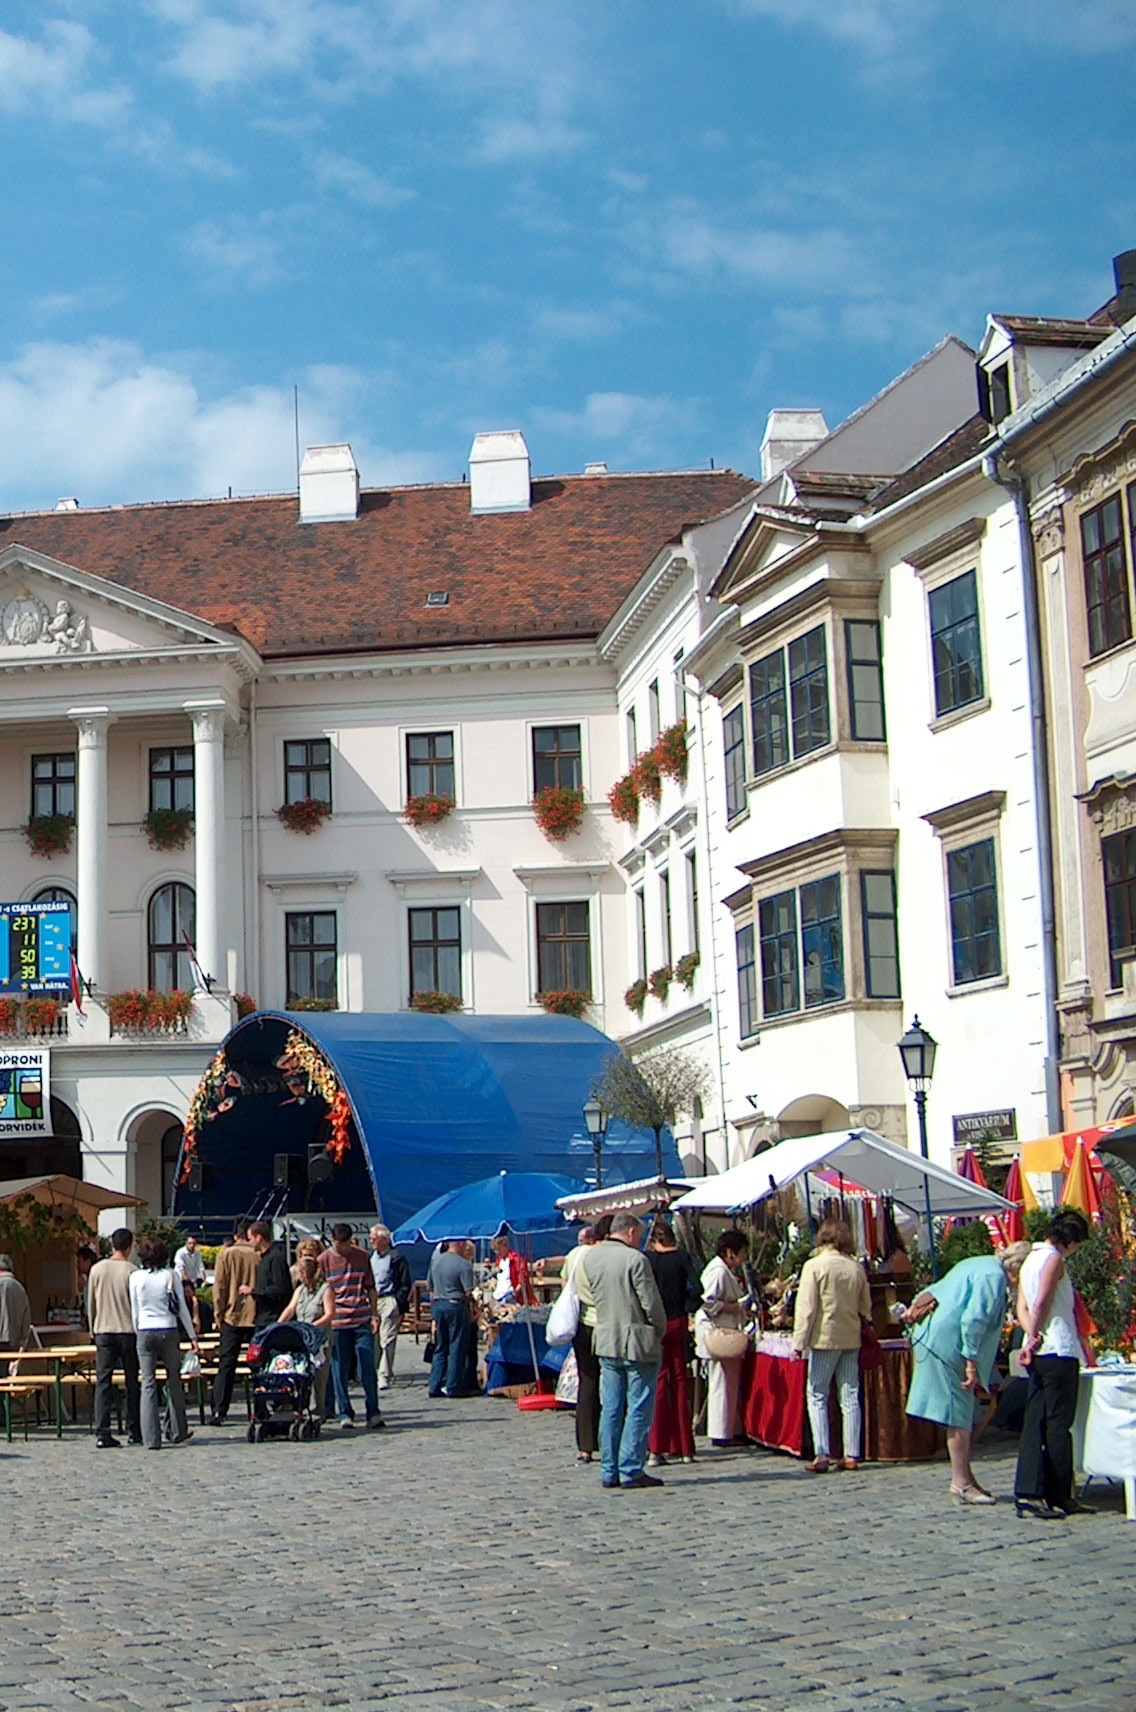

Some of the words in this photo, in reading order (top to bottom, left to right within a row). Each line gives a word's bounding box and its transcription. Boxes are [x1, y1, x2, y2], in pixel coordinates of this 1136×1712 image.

[11, 902, 68, 912] CSATLAKOZÁSIG
[13, 917, 36, 931] 237
[24, 933, 36, 946] 11
[20, 949, 36, 963] 50
[21, 966, 36, 980] 39
